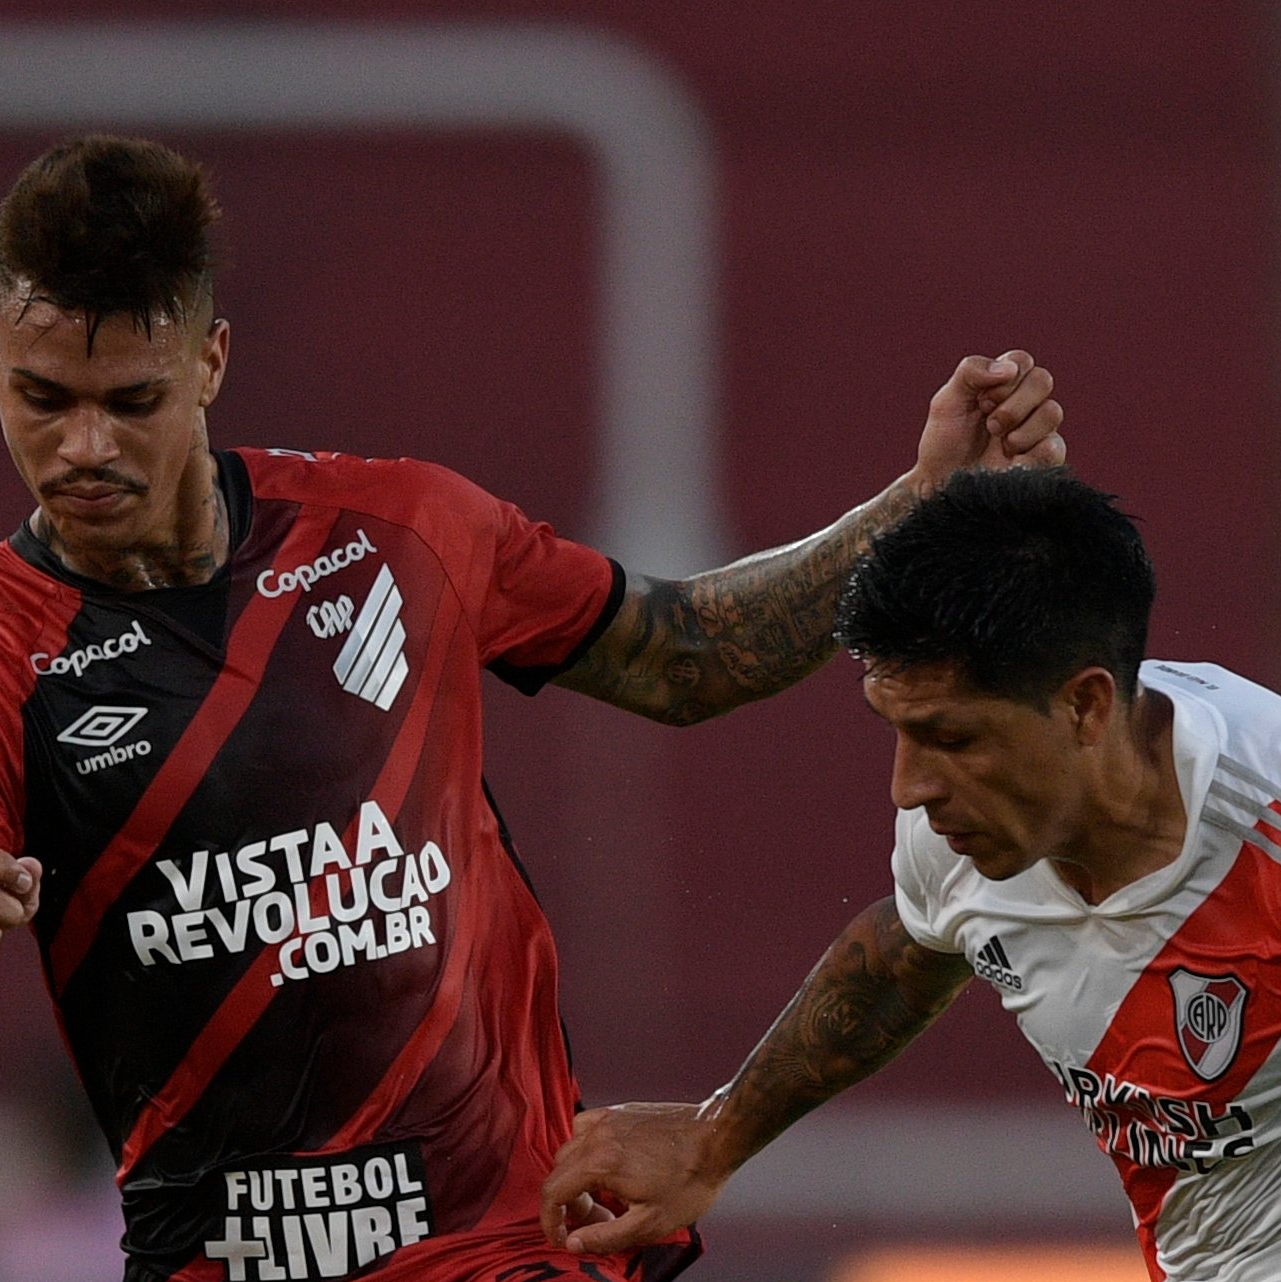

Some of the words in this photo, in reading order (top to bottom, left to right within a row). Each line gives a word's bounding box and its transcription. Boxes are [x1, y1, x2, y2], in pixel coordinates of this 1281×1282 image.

[256, 528, 378, 598] Copacol
[30, 619, 152, 677] Copacol
[75, 740, 152, 775] umbro
[224, 1152, 423, 1212] FUTEBOL
